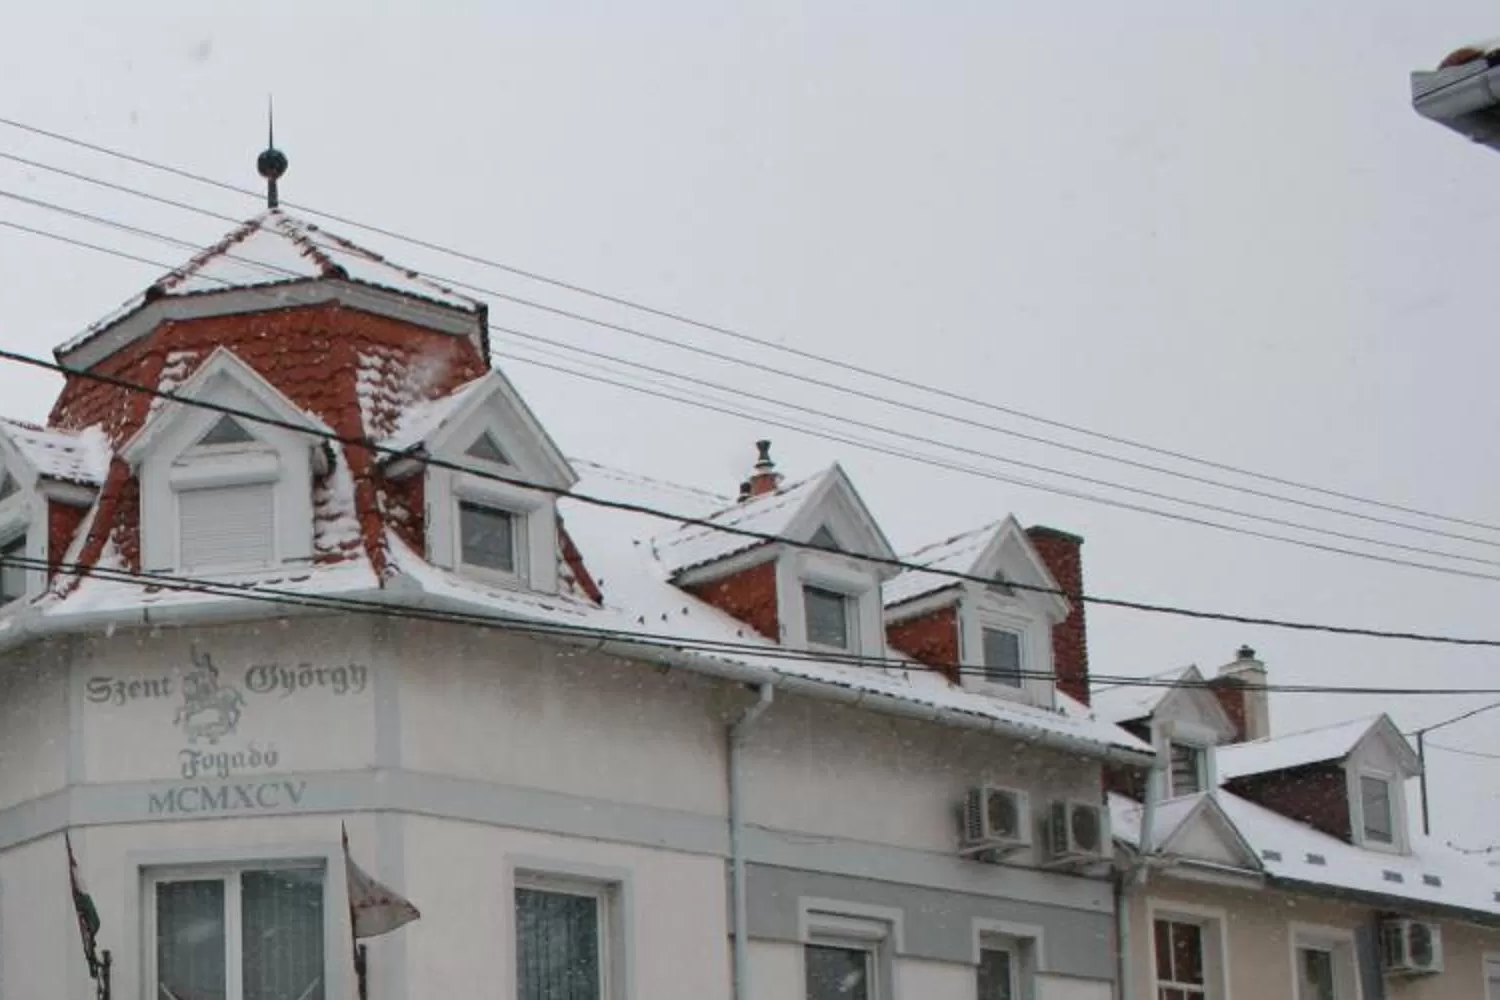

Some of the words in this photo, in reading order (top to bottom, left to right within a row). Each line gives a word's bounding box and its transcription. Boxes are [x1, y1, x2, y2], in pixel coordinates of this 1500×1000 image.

[86, 674, 172, 706] Szent
[178, 740, 279, 780] Fogadó
[148, 781, 307, 814] MCMXCV
